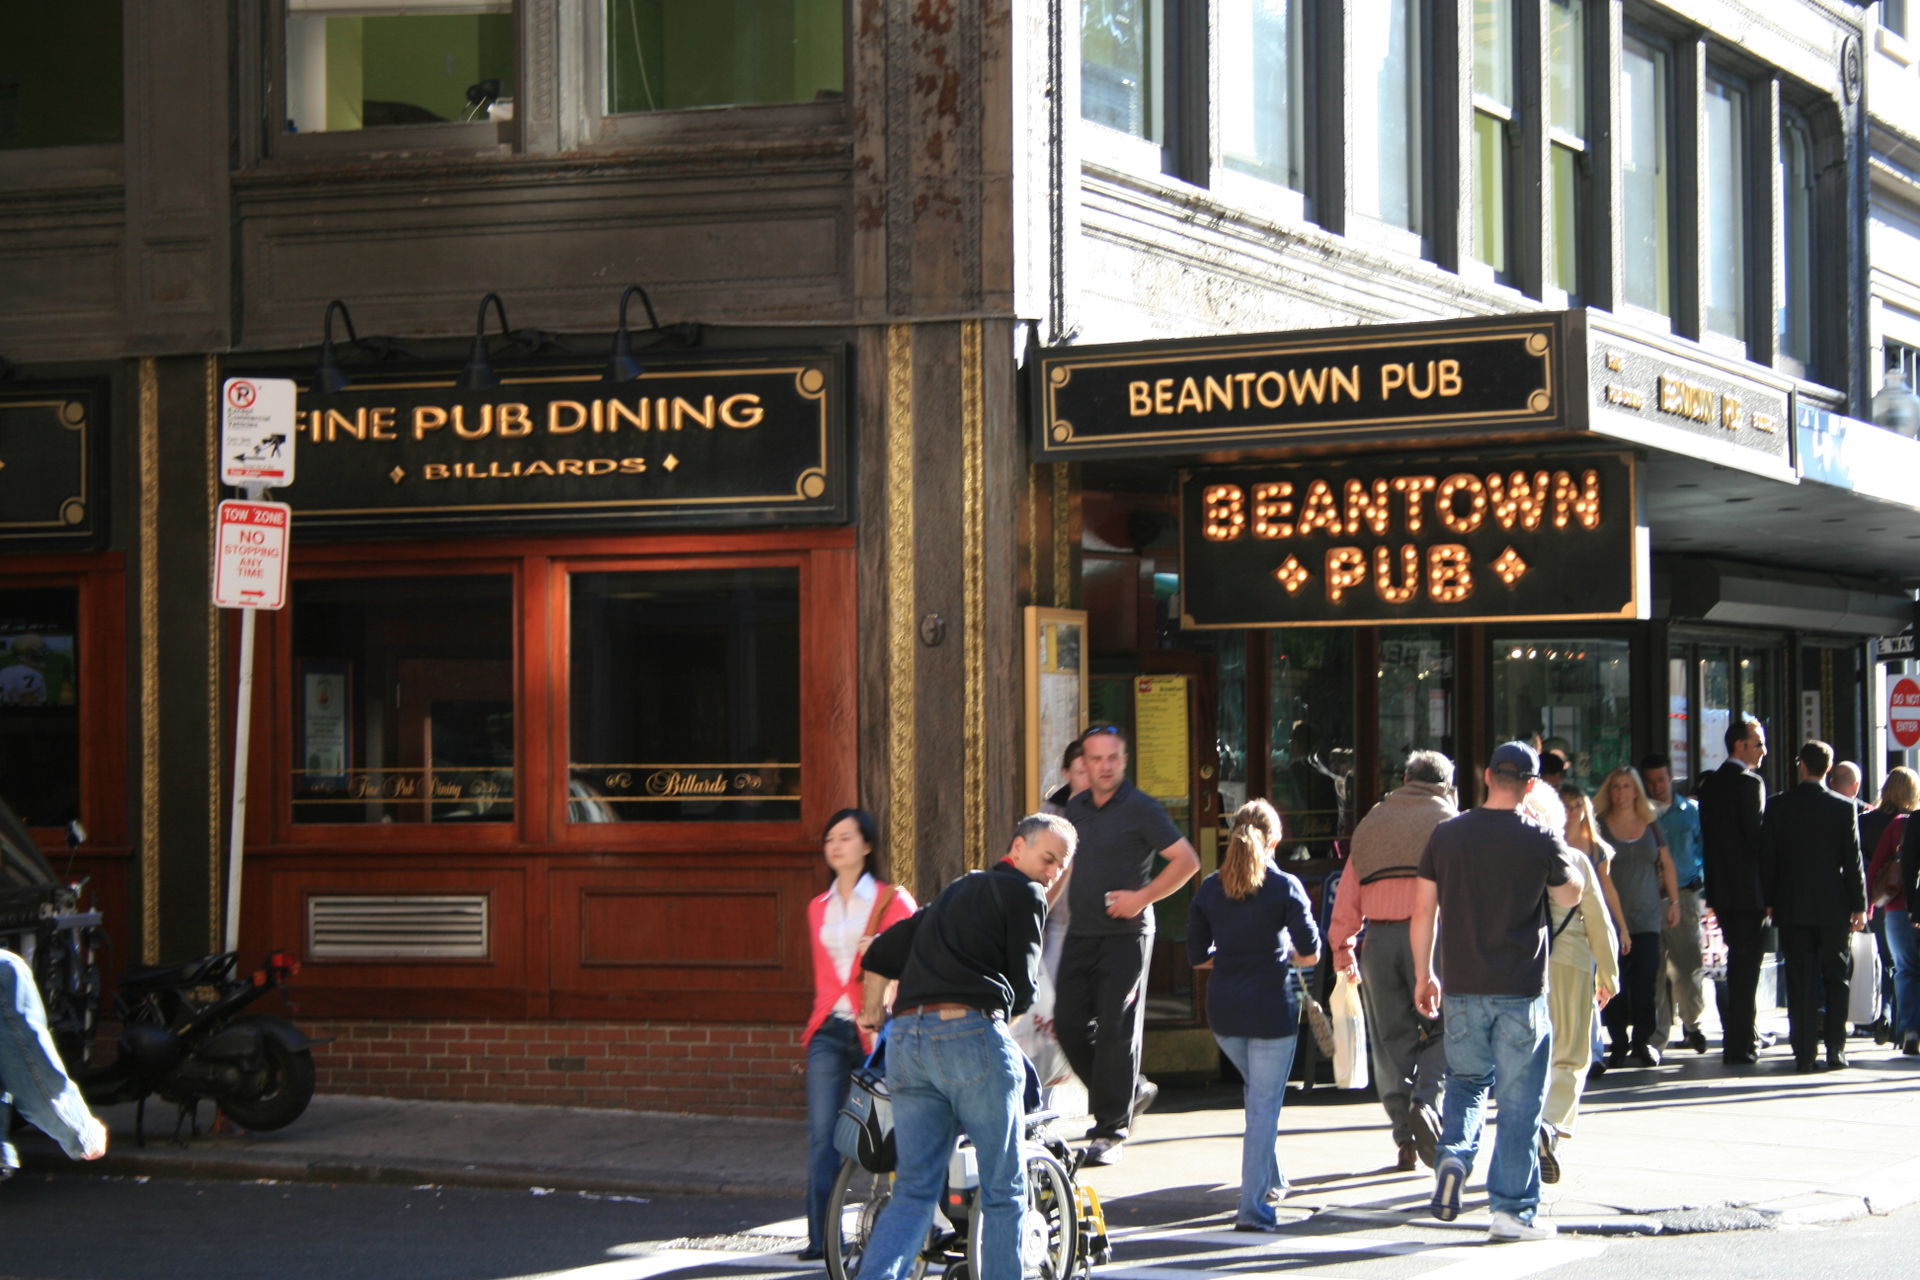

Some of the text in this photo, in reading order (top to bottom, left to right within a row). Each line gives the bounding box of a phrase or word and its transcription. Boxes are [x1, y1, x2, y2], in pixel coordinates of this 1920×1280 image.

[1128, 358, 1463, 417] BEANTOWN PUB
[412, 403, 533, 441] PUB
[547, 393, 765, 434] DINING
[423, 457, 647, 481] BILLIARDS
[1202, 469, 1602, 542] BEANTOWN
[224, 508, 284, 525] TOW ZONE
[240, 530, 265, 544] NO
[225, 544, 280, 558] STOPPING
[239, 557, 263, 567] ANY
[237, 567, 265, 579] TIME
[1324, 543, 1475, 605] PUB
[1893, 693, 1905, 705] DO
[1896, 721, 1919, 733] ENTER
[383, 773, 415, 799] Pub
